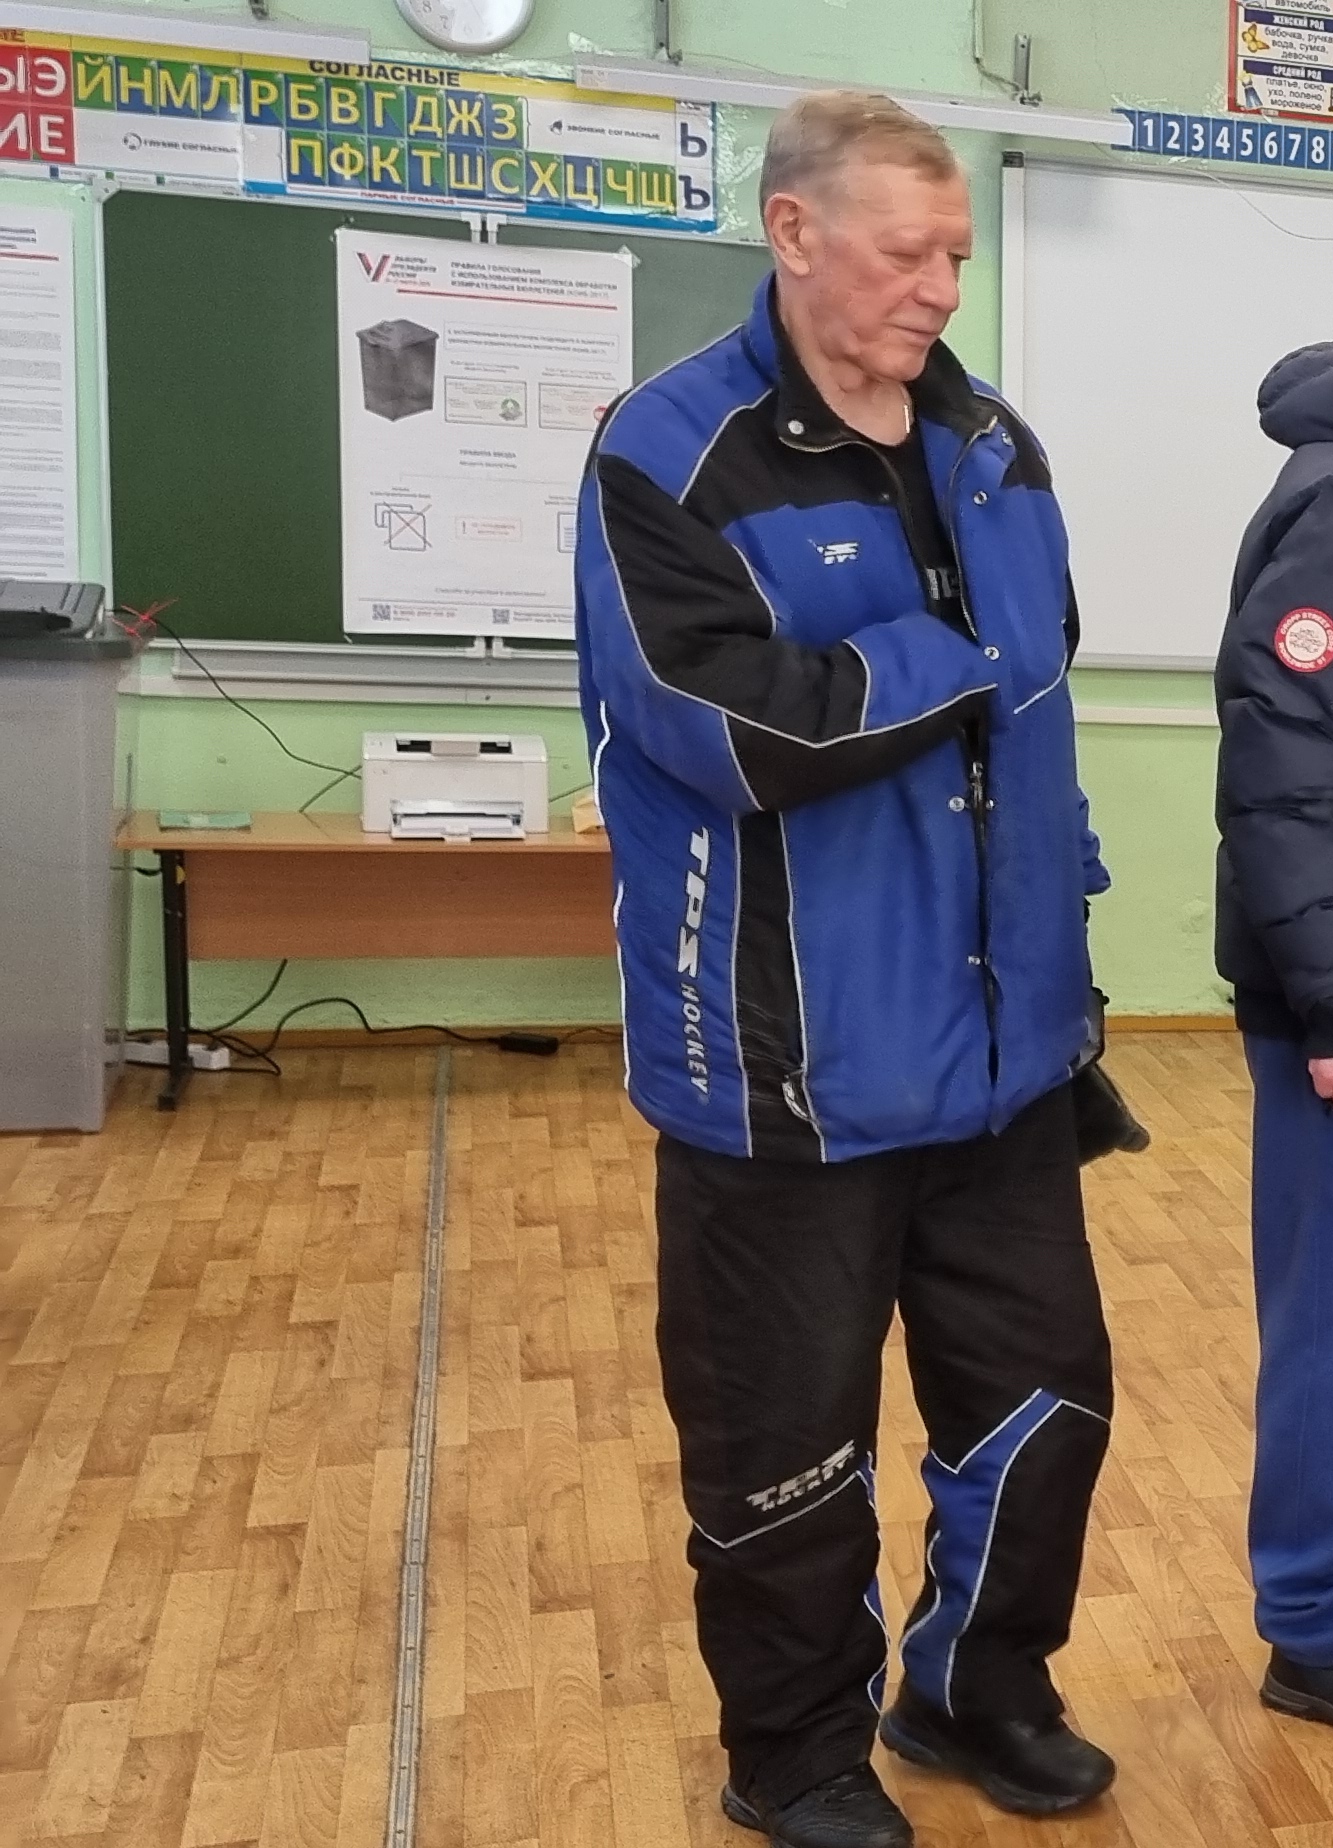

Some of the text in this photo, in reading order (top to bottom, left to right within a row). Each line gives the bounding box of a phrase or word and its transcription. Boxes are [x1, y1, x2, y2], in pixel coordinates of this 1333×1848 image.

[1309, 20, 1324, 30] РОД
[1281, 51, 1318, 62] девочка
[308, 59, 461, 88] СОГЛАСНЫЕ
[1307, 71, 1322, 80] РОД
[1270, 99, 1321, 111] мороженое
[1142, 118, 1155, 147] 1
[1166, 120, 1181, 150] 2
[1191, 123, 1205, 152] 3
[1215, 126, 1231, 155] 4
[1240, 128, 1253, 157] 5
[1264, 131, 1278, 159] 6
[1288, 133, 1302, 161] 7
[1311, 135, 1325, 164] 8
[680, 981, 711, 1096] HOCKEY
